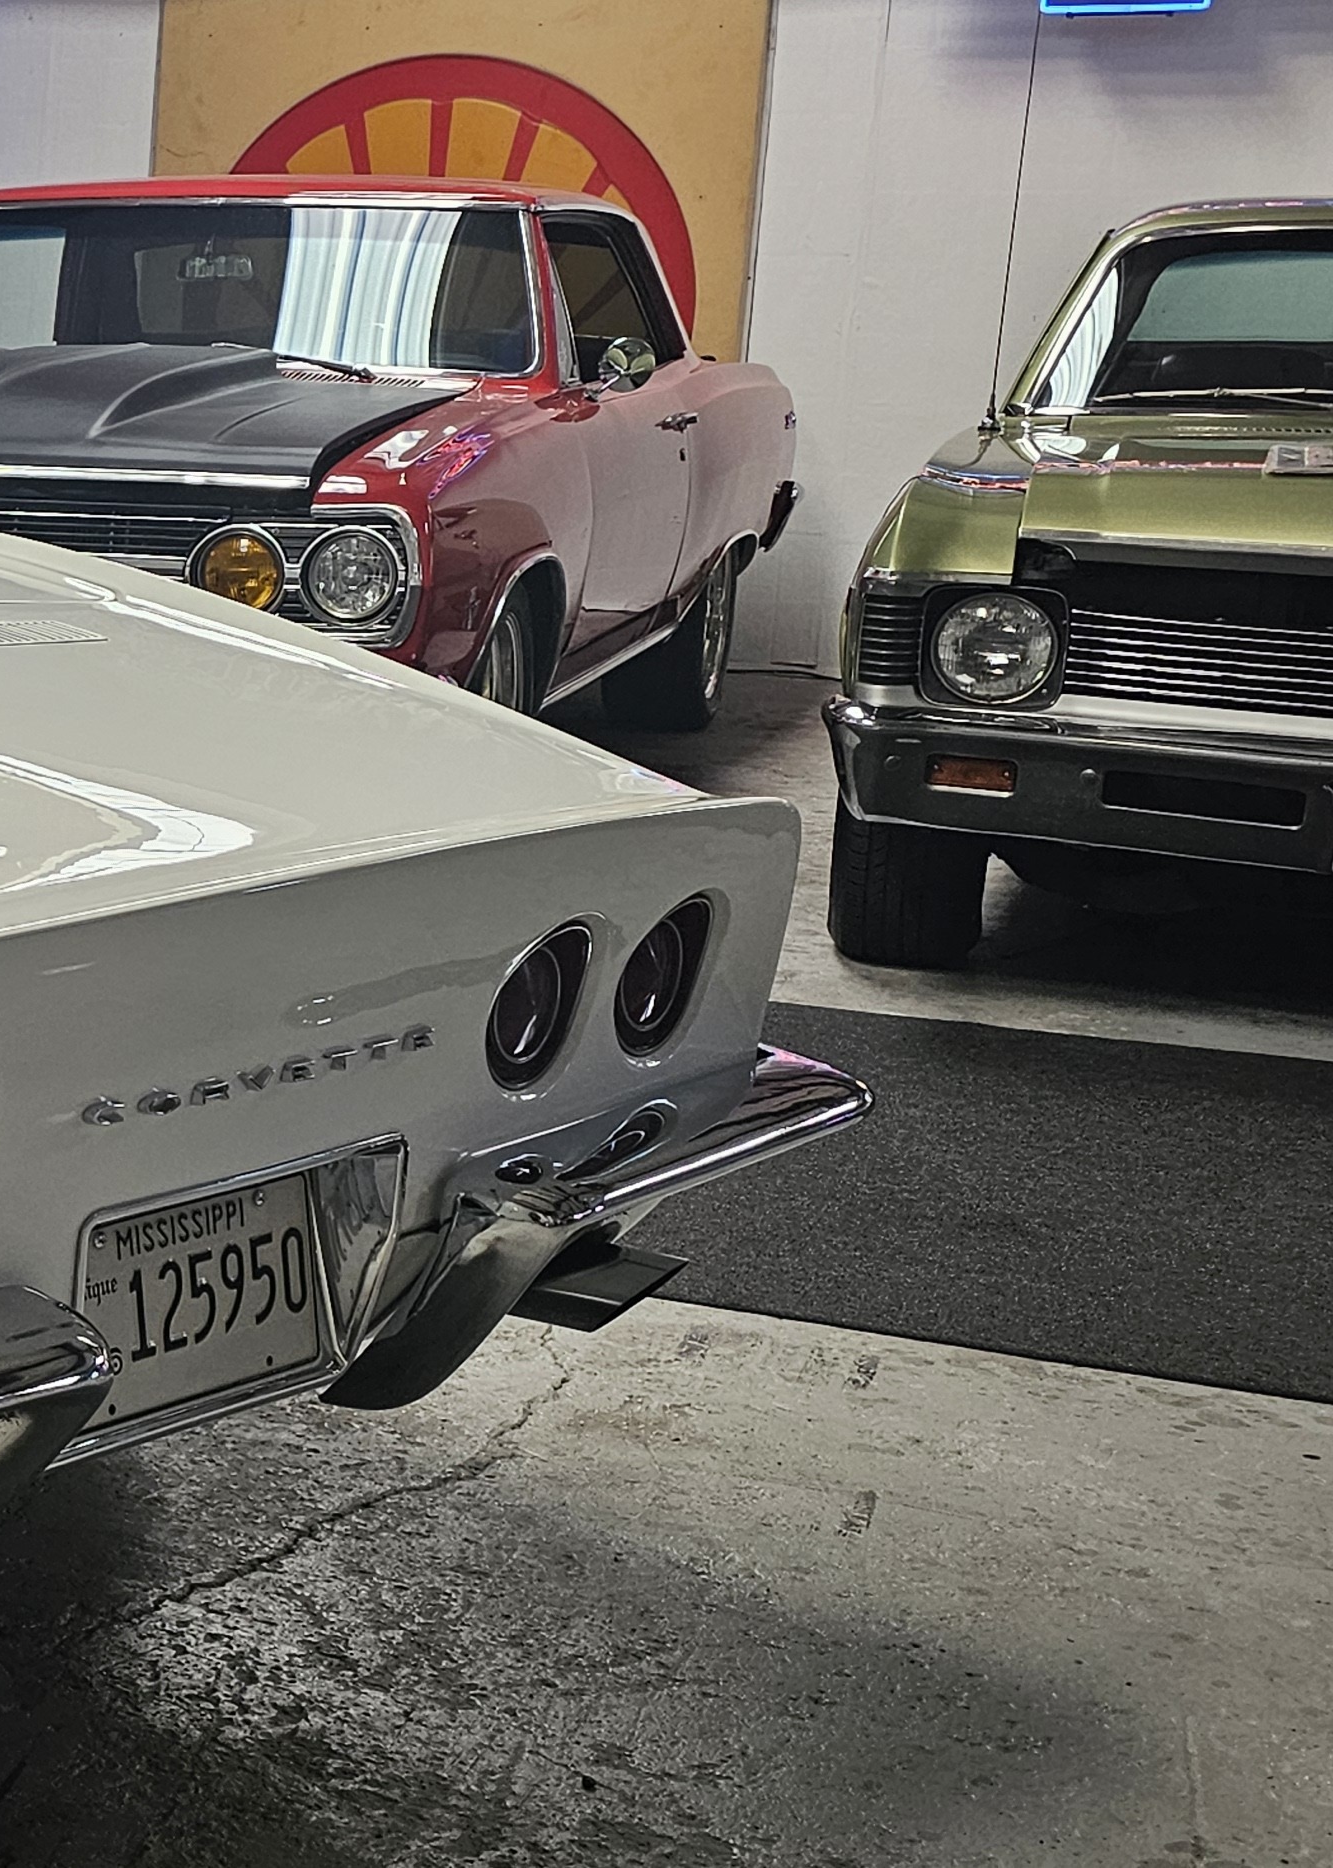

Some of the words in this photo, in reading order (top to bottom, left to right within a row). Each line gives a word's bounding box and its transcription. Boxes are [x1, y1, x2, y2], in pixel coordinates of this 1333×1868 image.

[81, 1023, 435, 1127] CORVETTE
[115, 1197, 245, 1261] MISSISSIPPI
[84, 1276, 118, 1307] ique
[129, 1227, 308, 1363] 125950
